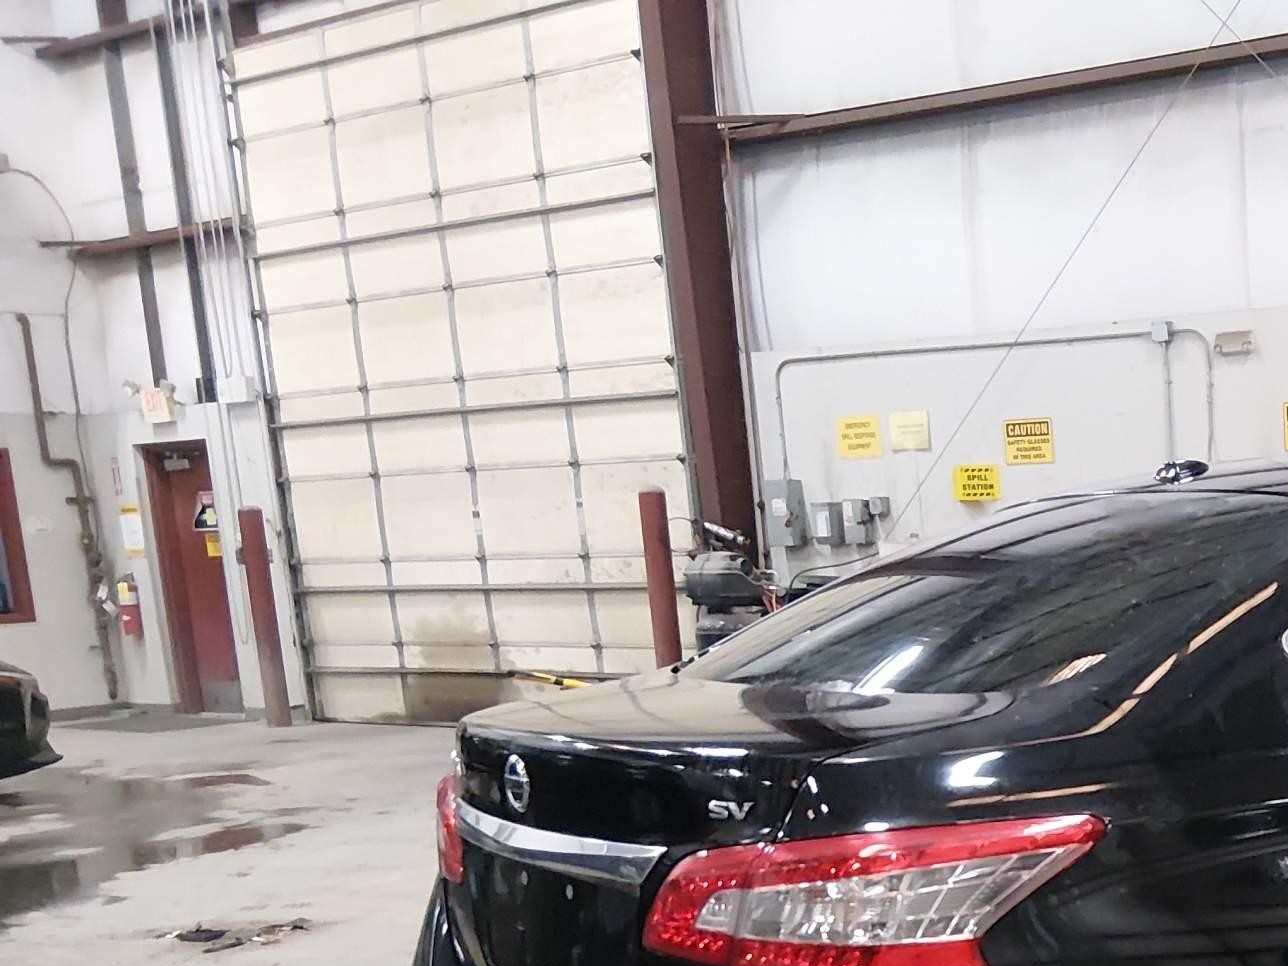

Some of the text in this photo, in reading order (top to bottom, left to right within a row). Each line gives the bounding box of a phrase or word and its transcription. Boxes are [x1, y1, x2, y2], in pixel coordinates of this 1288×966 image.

[1007, 423, 1048, 436] CAUTION
[962, 483, 995, 491] STATION
[708, 799, 755, 821] SV
